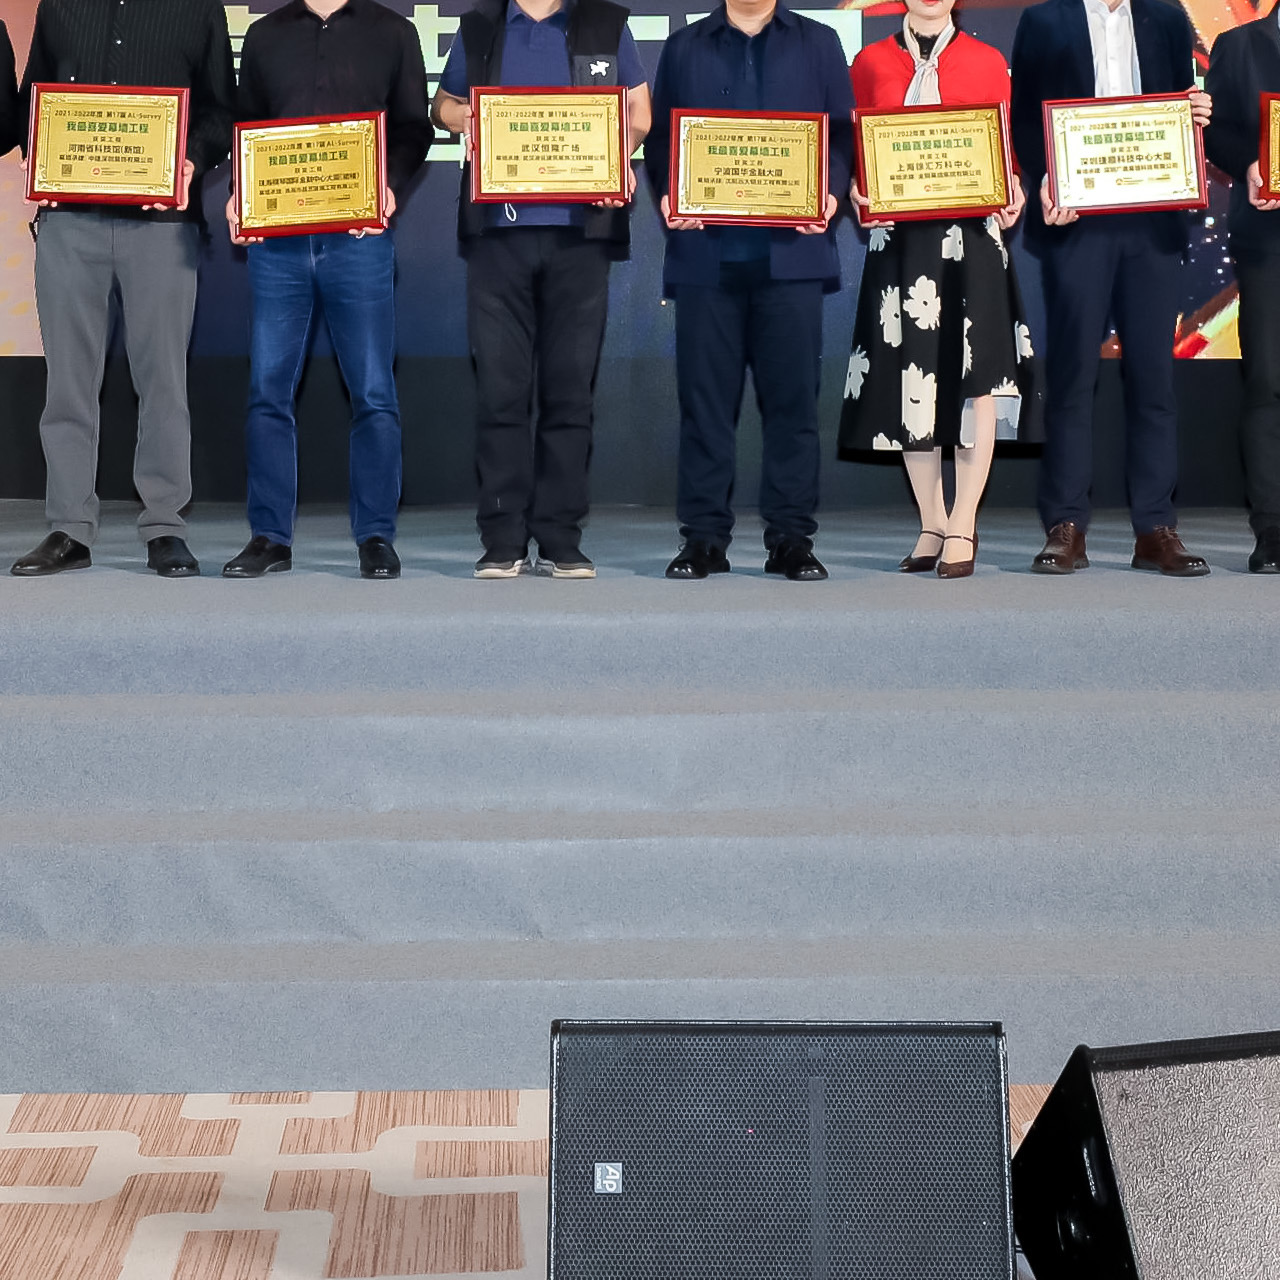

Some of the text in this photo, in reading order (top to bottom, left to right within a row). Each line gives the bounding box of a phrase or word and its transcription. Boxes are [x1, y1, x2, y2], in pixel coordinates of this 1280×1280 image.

[67, 122, 149, 133] 我最喜爱幕墙工程
[509, 122, 591, 132] 我最喜爱幕墙工程
[1083, 130, 1165, 145] 我最喜爱幕墙工程
[892, 138, 972, 151] 我最喜爱幕墙工程
[708, 145, 790, 157] 我最喜爱幕墙工程
[269, 150, 348, 166] 我最喜爱幕墙工程
